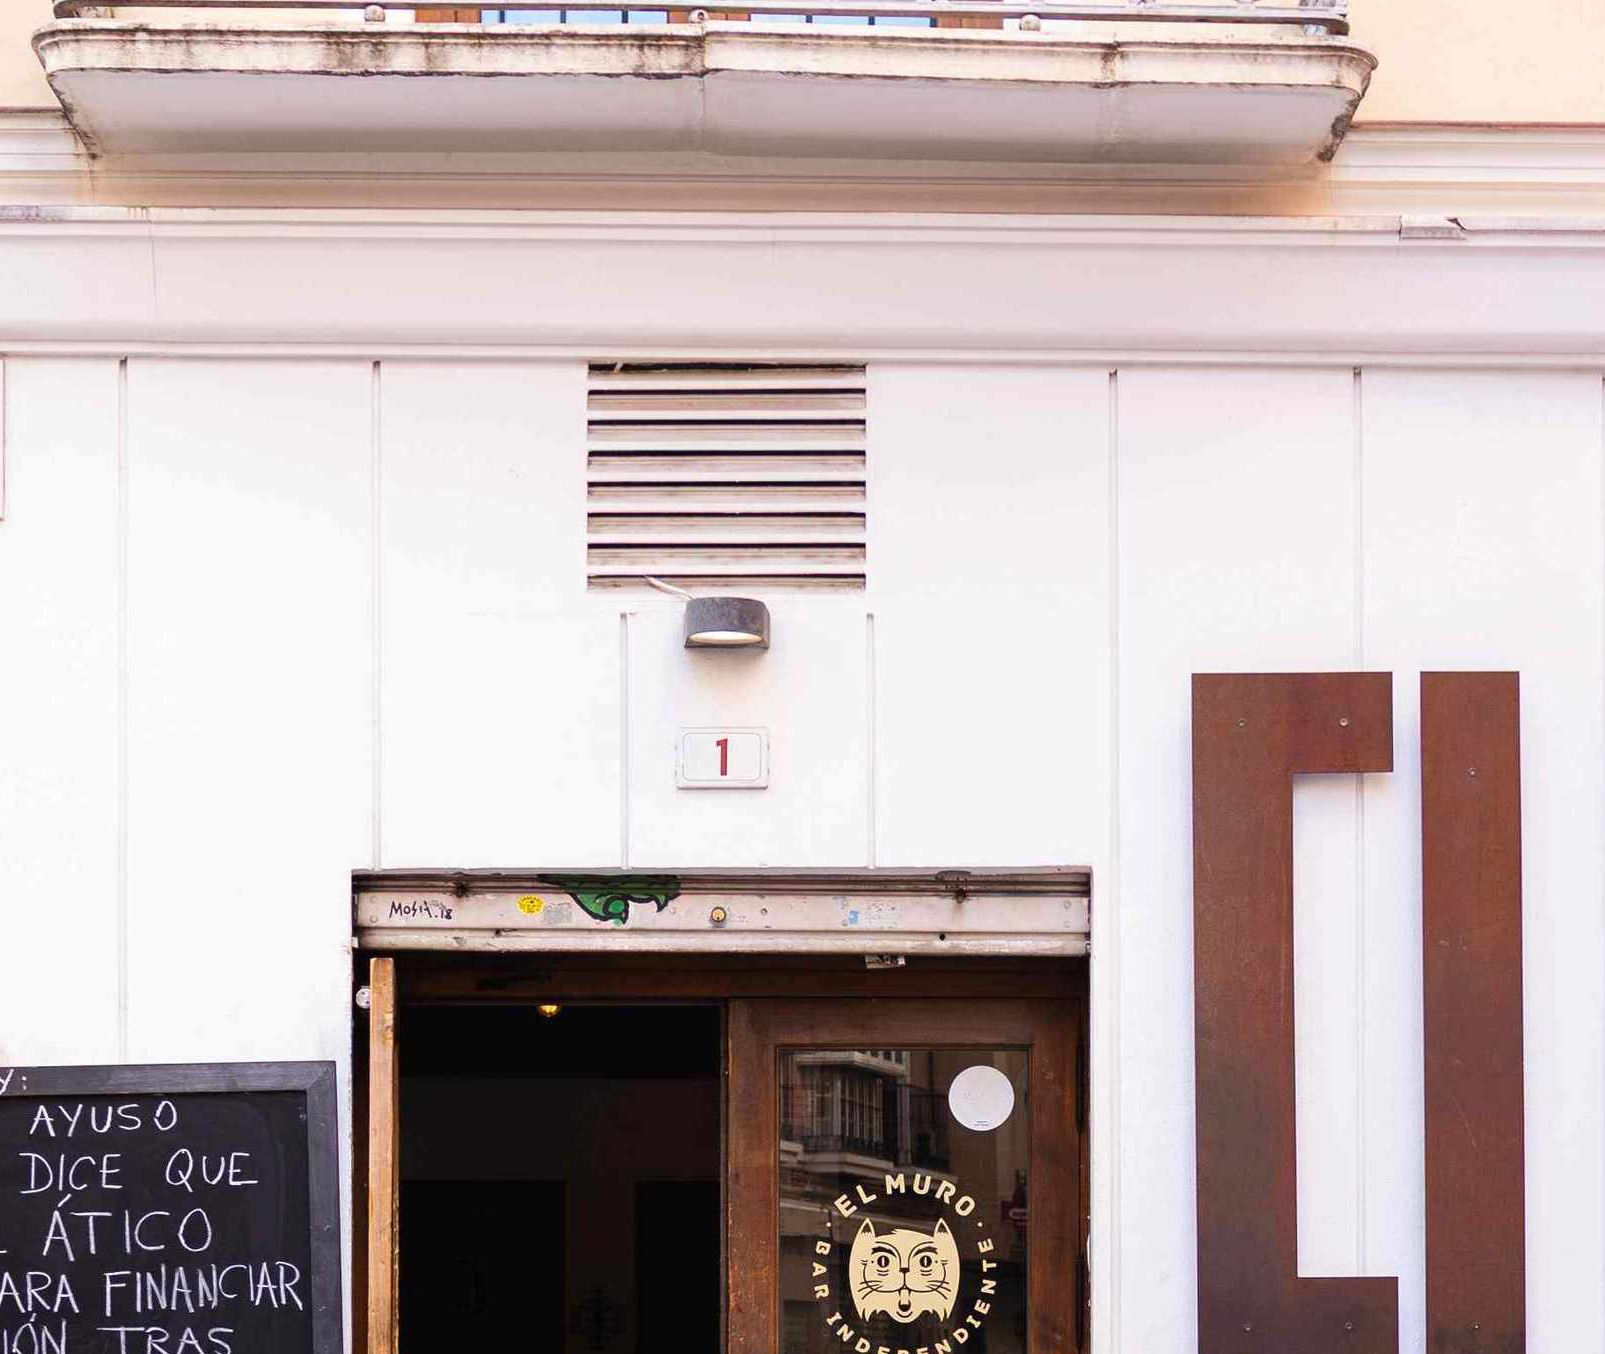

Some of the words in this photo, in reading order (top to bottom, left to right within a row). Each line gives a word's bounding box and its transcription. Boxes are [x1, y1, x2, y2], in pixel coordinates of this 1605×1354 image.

[715, 737, 729, 777] 1
[29, 1100, 178, 1135] AYUSO
[18, 1152, 123, 1194] DICE
[165, 1148, 259, 1191] QUE
[834, 1184, 877, 1218] EL
[885, 1173, 976, 1217] MURO
[42, 1193, 212, 1260] ÁTICO
[103, 1260, 303, 1317] FINANCIAR
[812, 1240, 832, 1299] BAR
